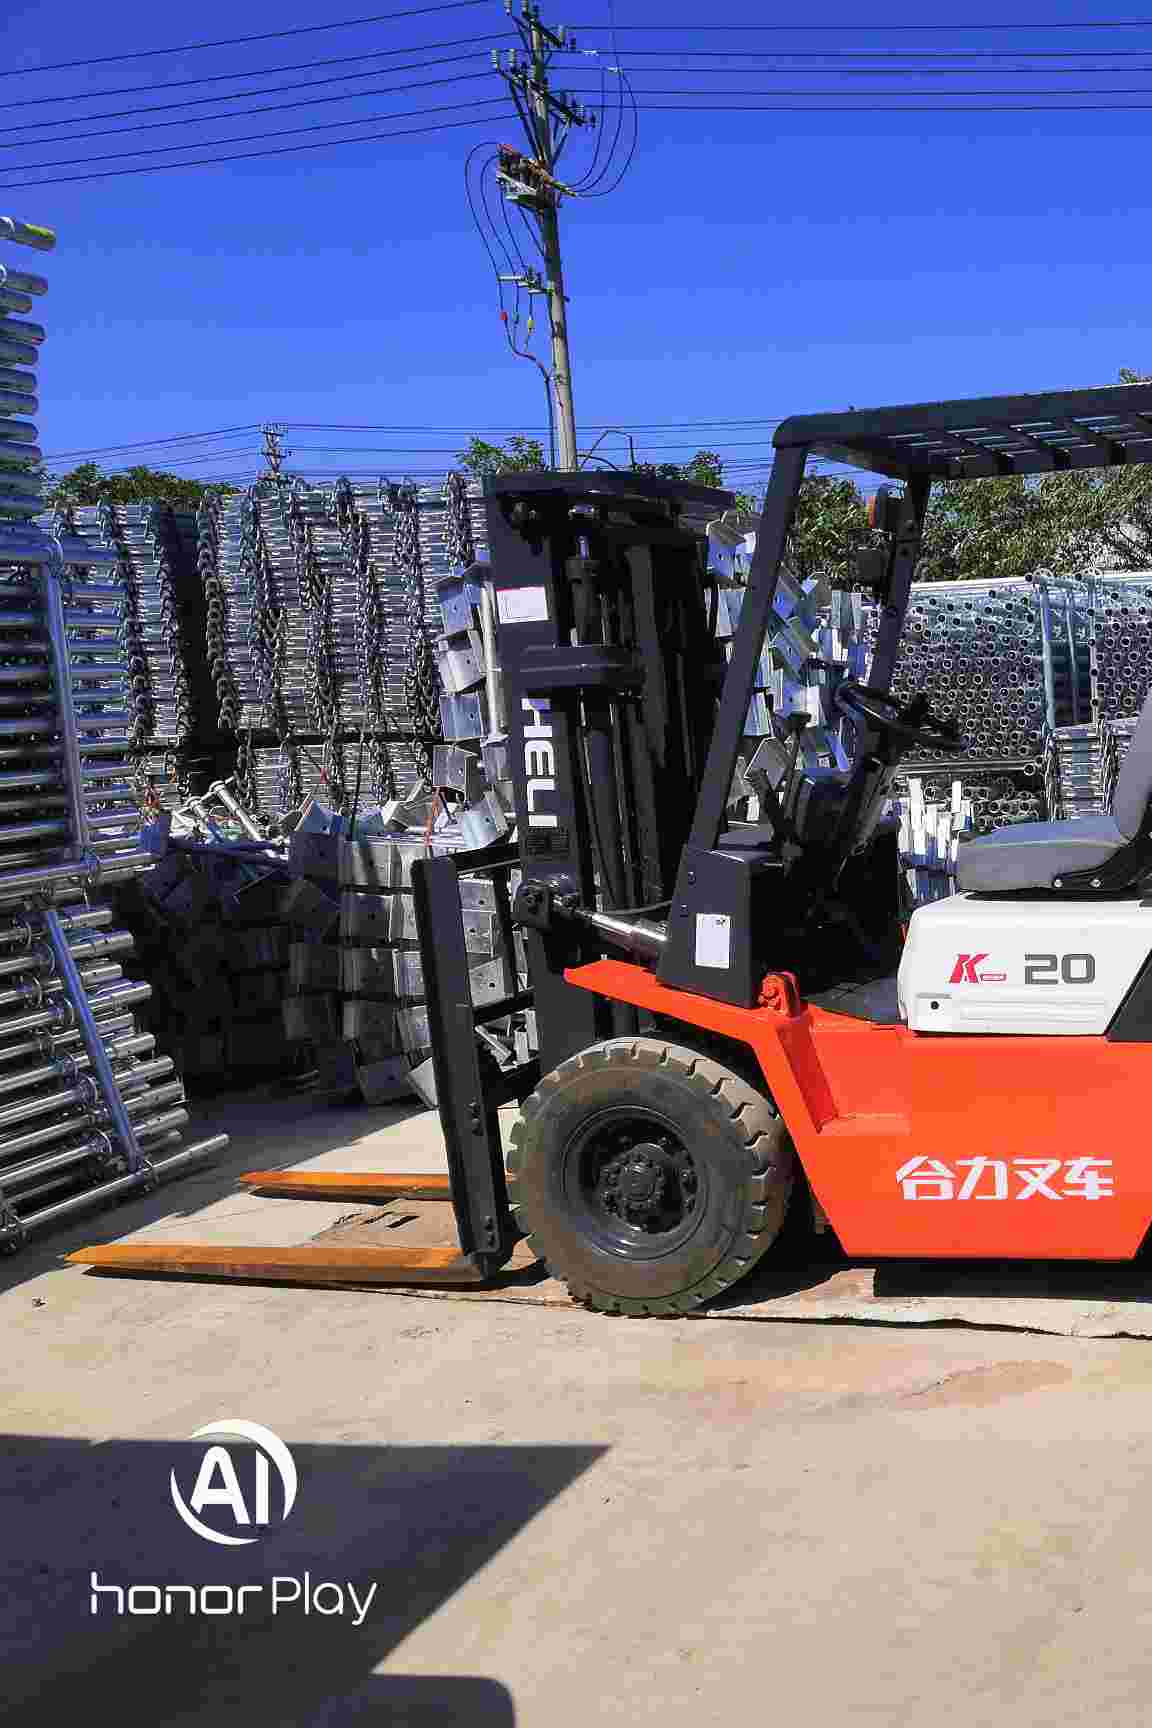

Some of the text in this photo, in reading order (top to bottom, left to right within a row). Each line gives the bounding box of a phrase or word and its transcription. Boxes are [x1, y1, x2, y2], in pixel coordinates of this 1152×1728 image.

[521, 698, 557, 828] HELI
[1024, 953, 1096, 985] 20
[895, 1156, 1114, 1201] 合力叉车
